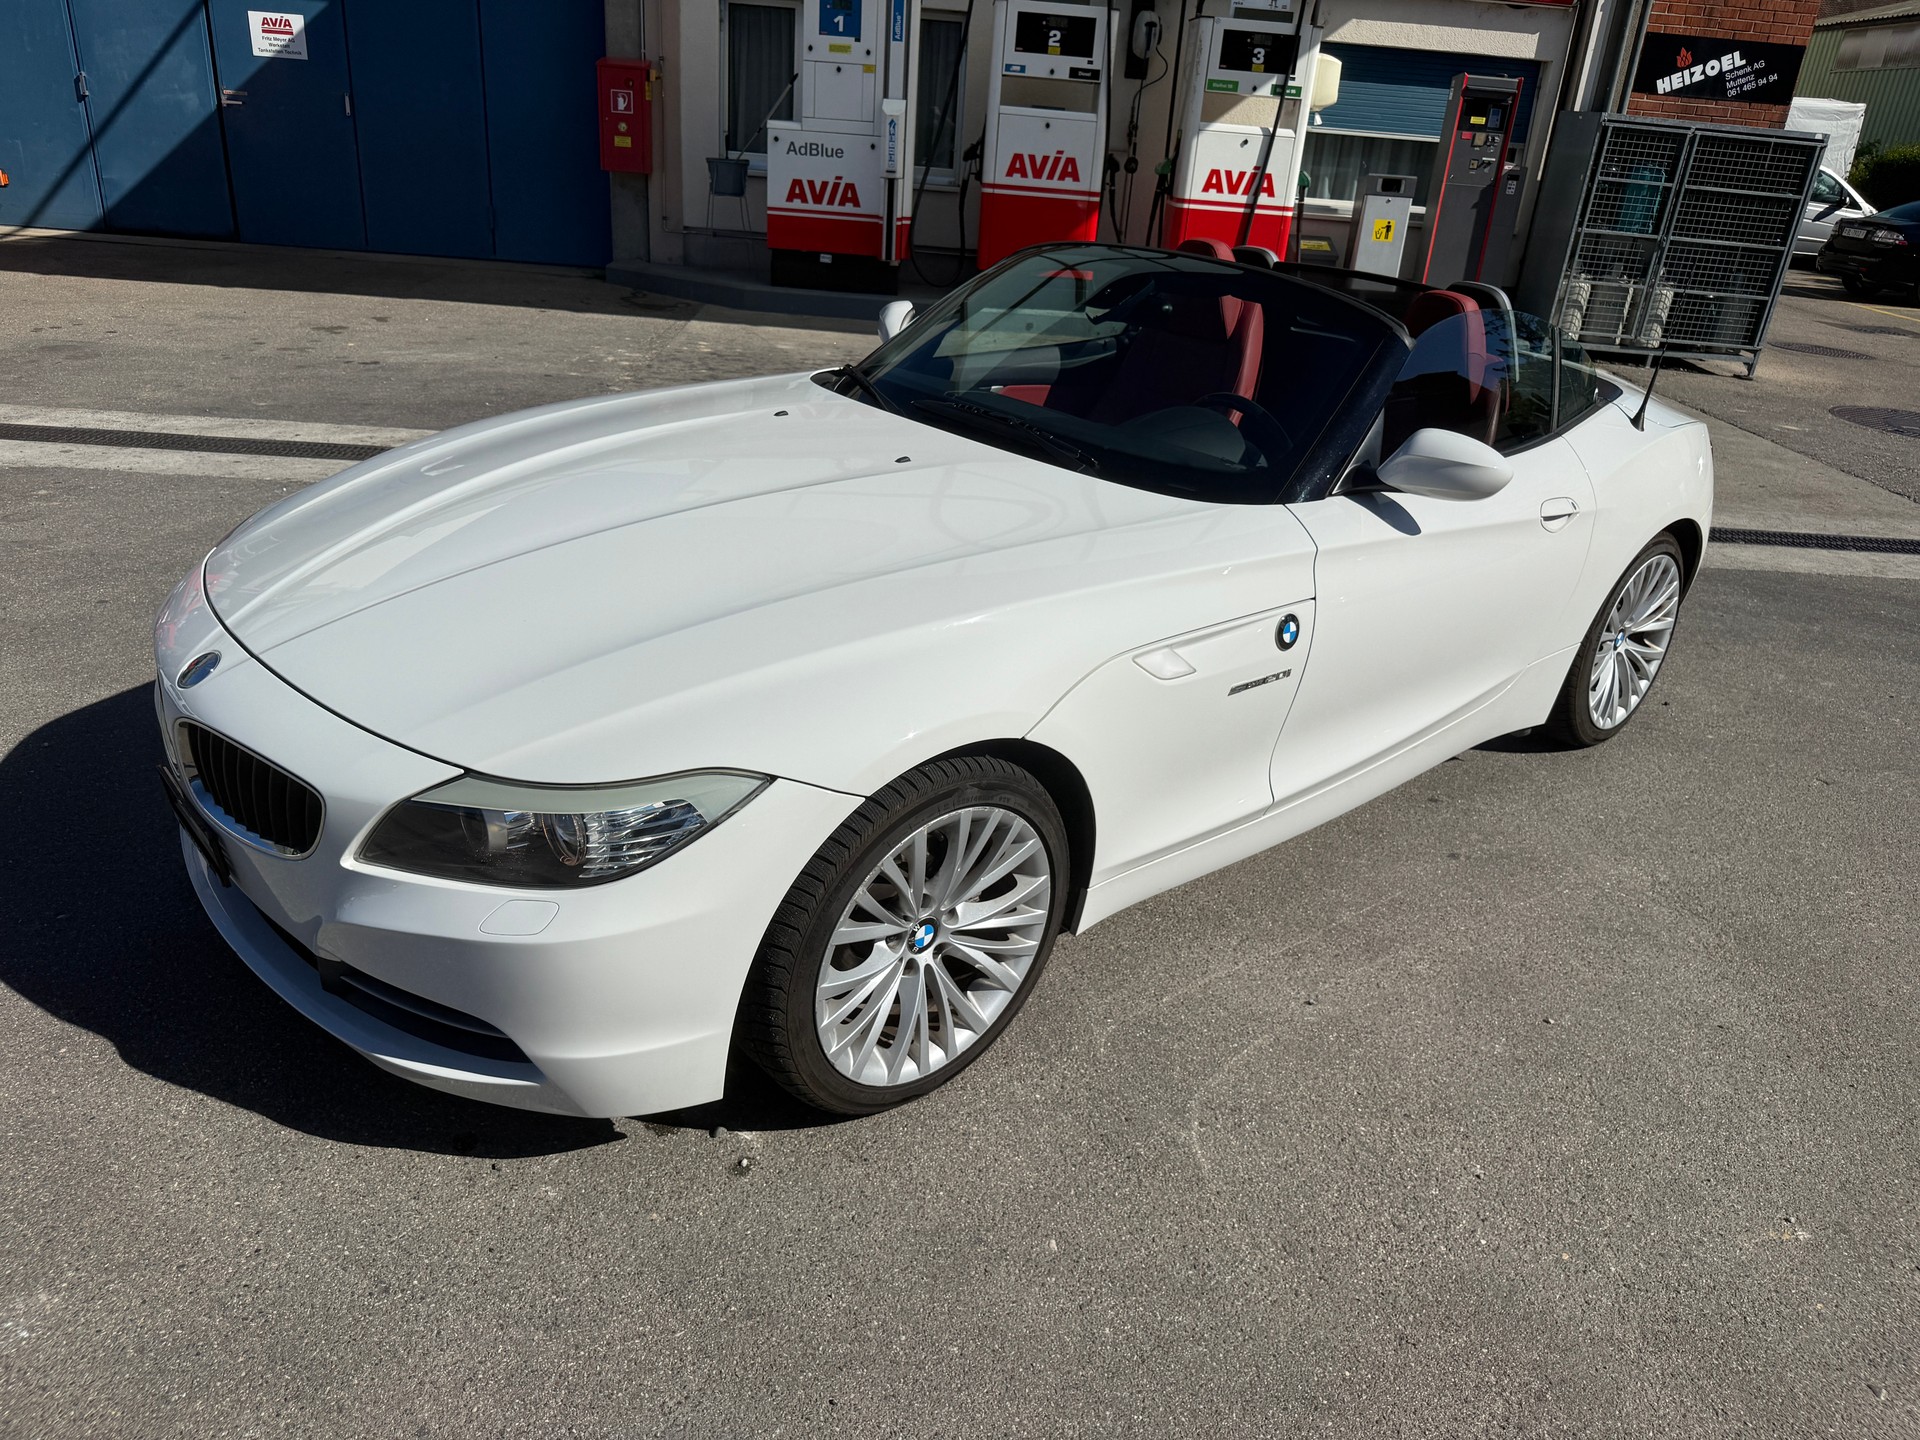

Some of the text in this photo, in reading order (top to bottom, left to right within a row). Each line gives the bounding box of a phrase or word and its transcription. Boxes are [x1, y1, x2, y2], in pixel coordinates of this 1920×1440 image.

[261, 16, 293, 28] AVIA
[833, 15, 844, 32] 1
[1048, 29, 1062, 47] 2
[1251, 47, 1265, 64] 3
[1656, 50, 1747, 95] HEIZOEL
[1725, 59, 1766, 81] Schenk AG
[1725, 73, 1755, 90] Muttenz
[1726, 72, 1778, 98] 061 465 94 94
[786, 141, 845, 159] AdBlue
[1005, 149, 1081, 183] AVIA
[1201, 165, 1276, 198] AVIA
[785, 176, 862, 209] AVIA
